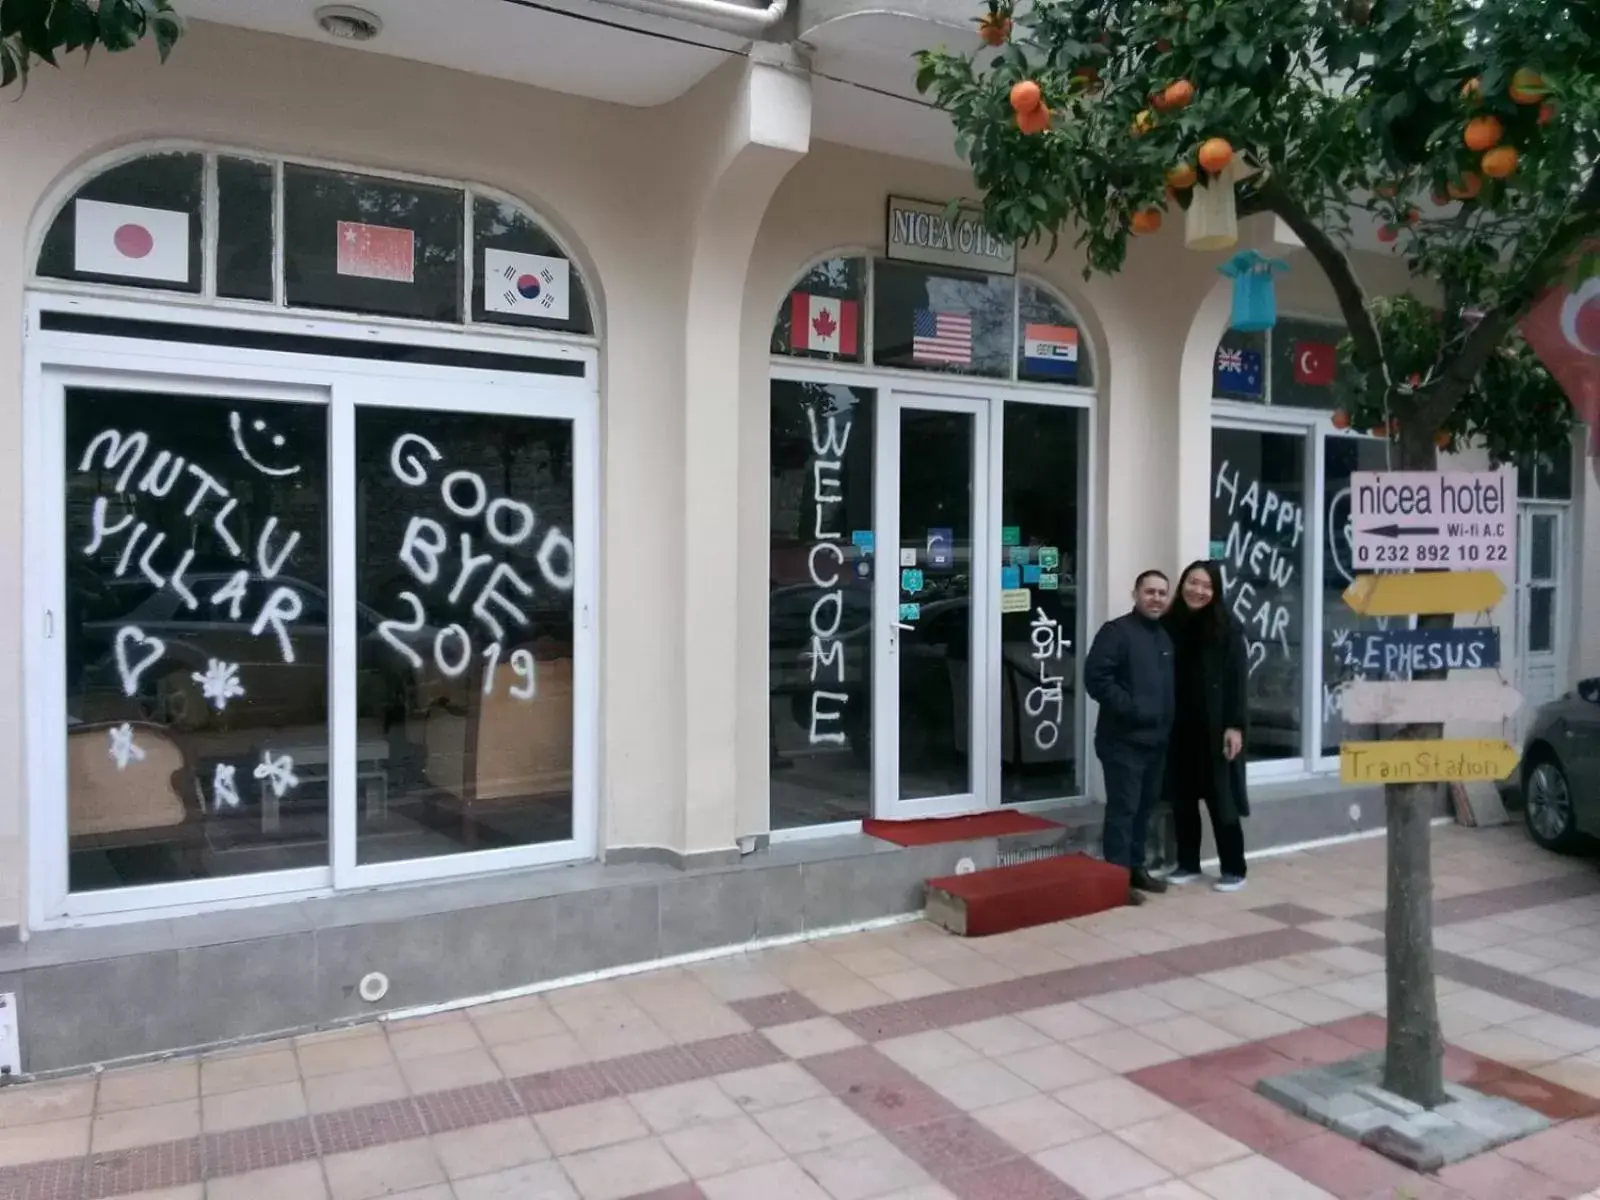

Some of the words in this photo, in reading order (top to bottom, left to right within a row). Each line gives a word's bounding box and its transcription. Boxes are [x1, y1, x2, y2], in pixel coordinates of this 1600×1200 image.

[893, 208, 955, 252] NICEA
[390, 433, 575, 590] GOOD
[1215, 460, 1304, 548] HAPPY
[1359, 476, 1432, 515] nicea
[1440, 475, 1505, 515] hotel
[1447, 523, 1479, 538] Wi-fi
[83, 496, 302, 663] YILLAR
[400, 516, 534, 641] BYE
[807, 405, 852, 745] WELCOME
[1224, 520, 1294, 588] NEW
[1358, 545, 1369, 562] 0
[1375, 544, 1409, 562] 232
[1416, 544, 1450, 562] 892
[1458, 544, 1479, 562] 10
[1486, 544, 1508, 562] 22
[377, 591, 534, 700] 2019
[1219, 565, 1291, 662] YEAR
[1362, 635, 1486, 673] EPHESUS
[1024, 606, 1072, 750] 환영
